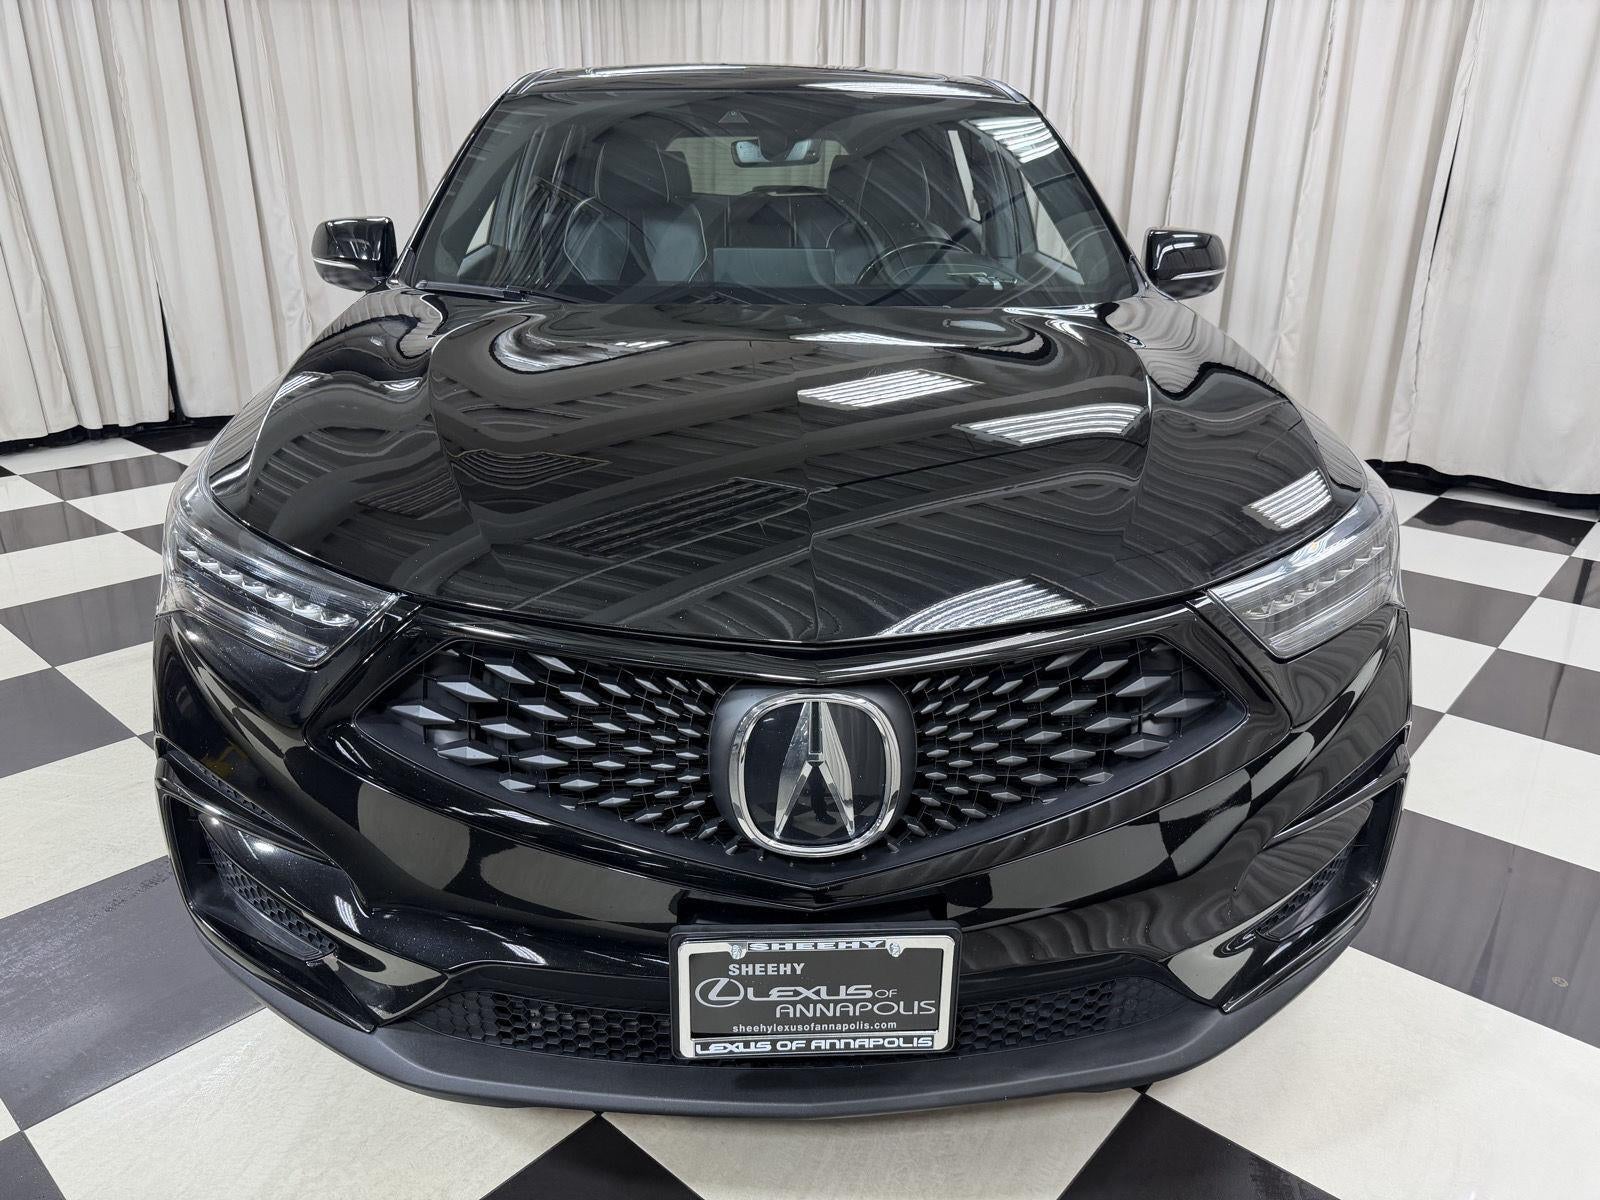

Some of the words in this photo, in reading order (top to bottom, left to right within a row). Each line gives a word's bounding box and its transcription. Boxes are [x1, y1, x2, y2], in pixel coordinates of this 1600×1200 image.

[749, 940, 884, 951] SHEEHY
[728, 962, 805, 976] SHEEHY
[747, 984, 872, 1001] LEXUS
[874, 988, 898, 999] OF
[776, 1000, 936, 1018] ANNAPOLIS
[732, 1021, 897, 1033] sheehylexusofannapolis.com
[695, 1041, 772, 1054] LEXUS
[776, 1040, 805, 1051] OF
[810, 1036, 933, 1050] ANNAPOLIS
